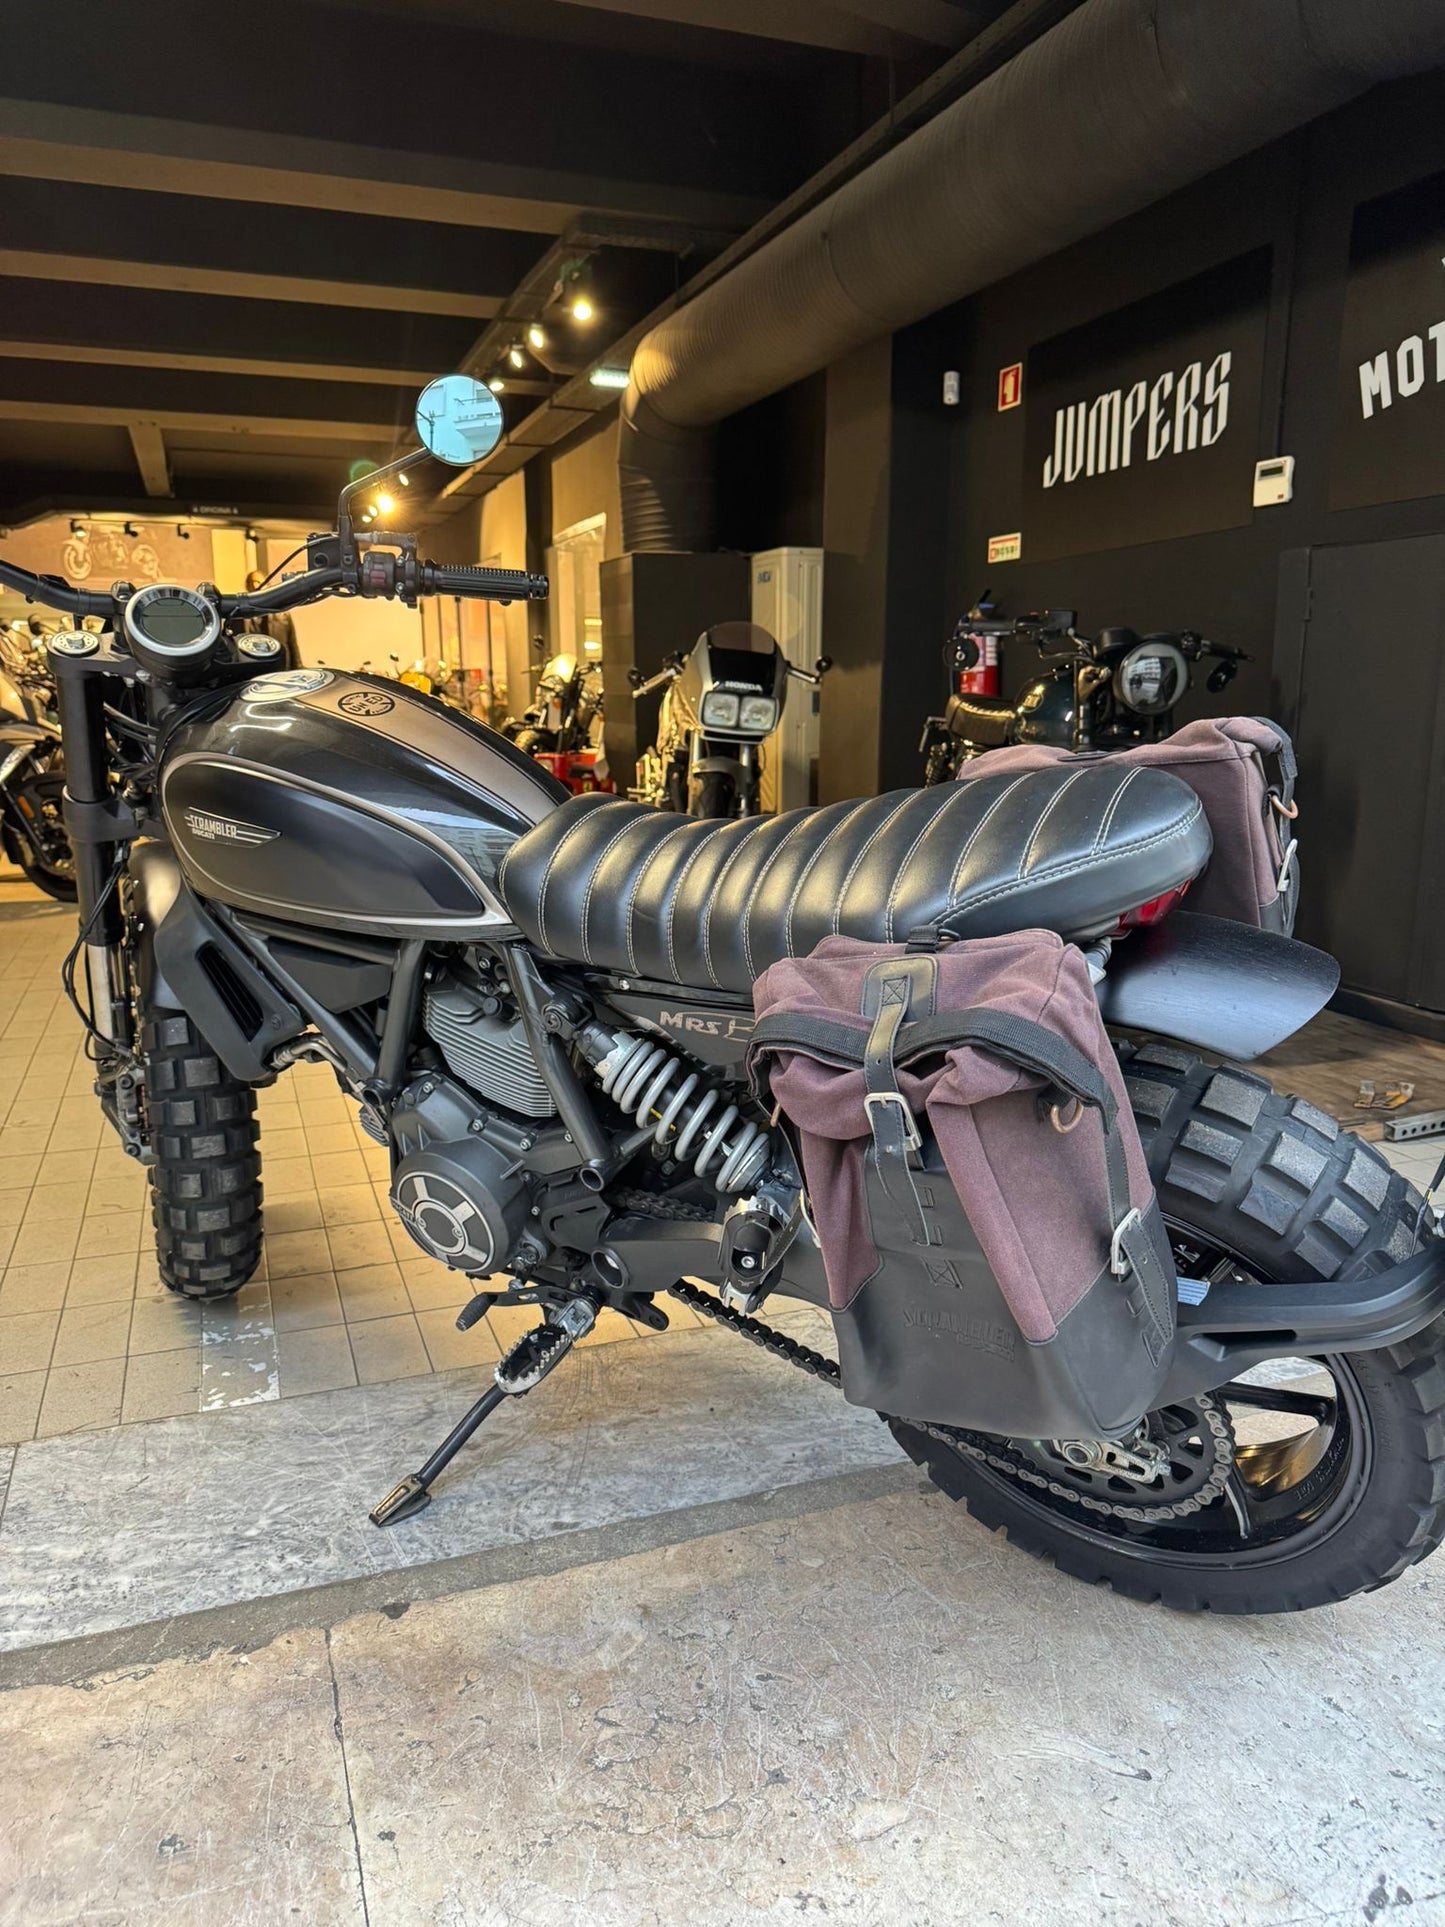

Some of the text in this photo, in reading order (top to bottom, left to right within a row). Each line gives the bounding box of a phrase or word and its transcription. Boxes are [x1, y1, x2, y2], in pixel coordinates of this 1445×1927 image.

[1043, 351, 1231, 488] JUMPERS
[724, 680, 763, 692] HONDA
[186, 814, 237, 839] SCRAMBLER
